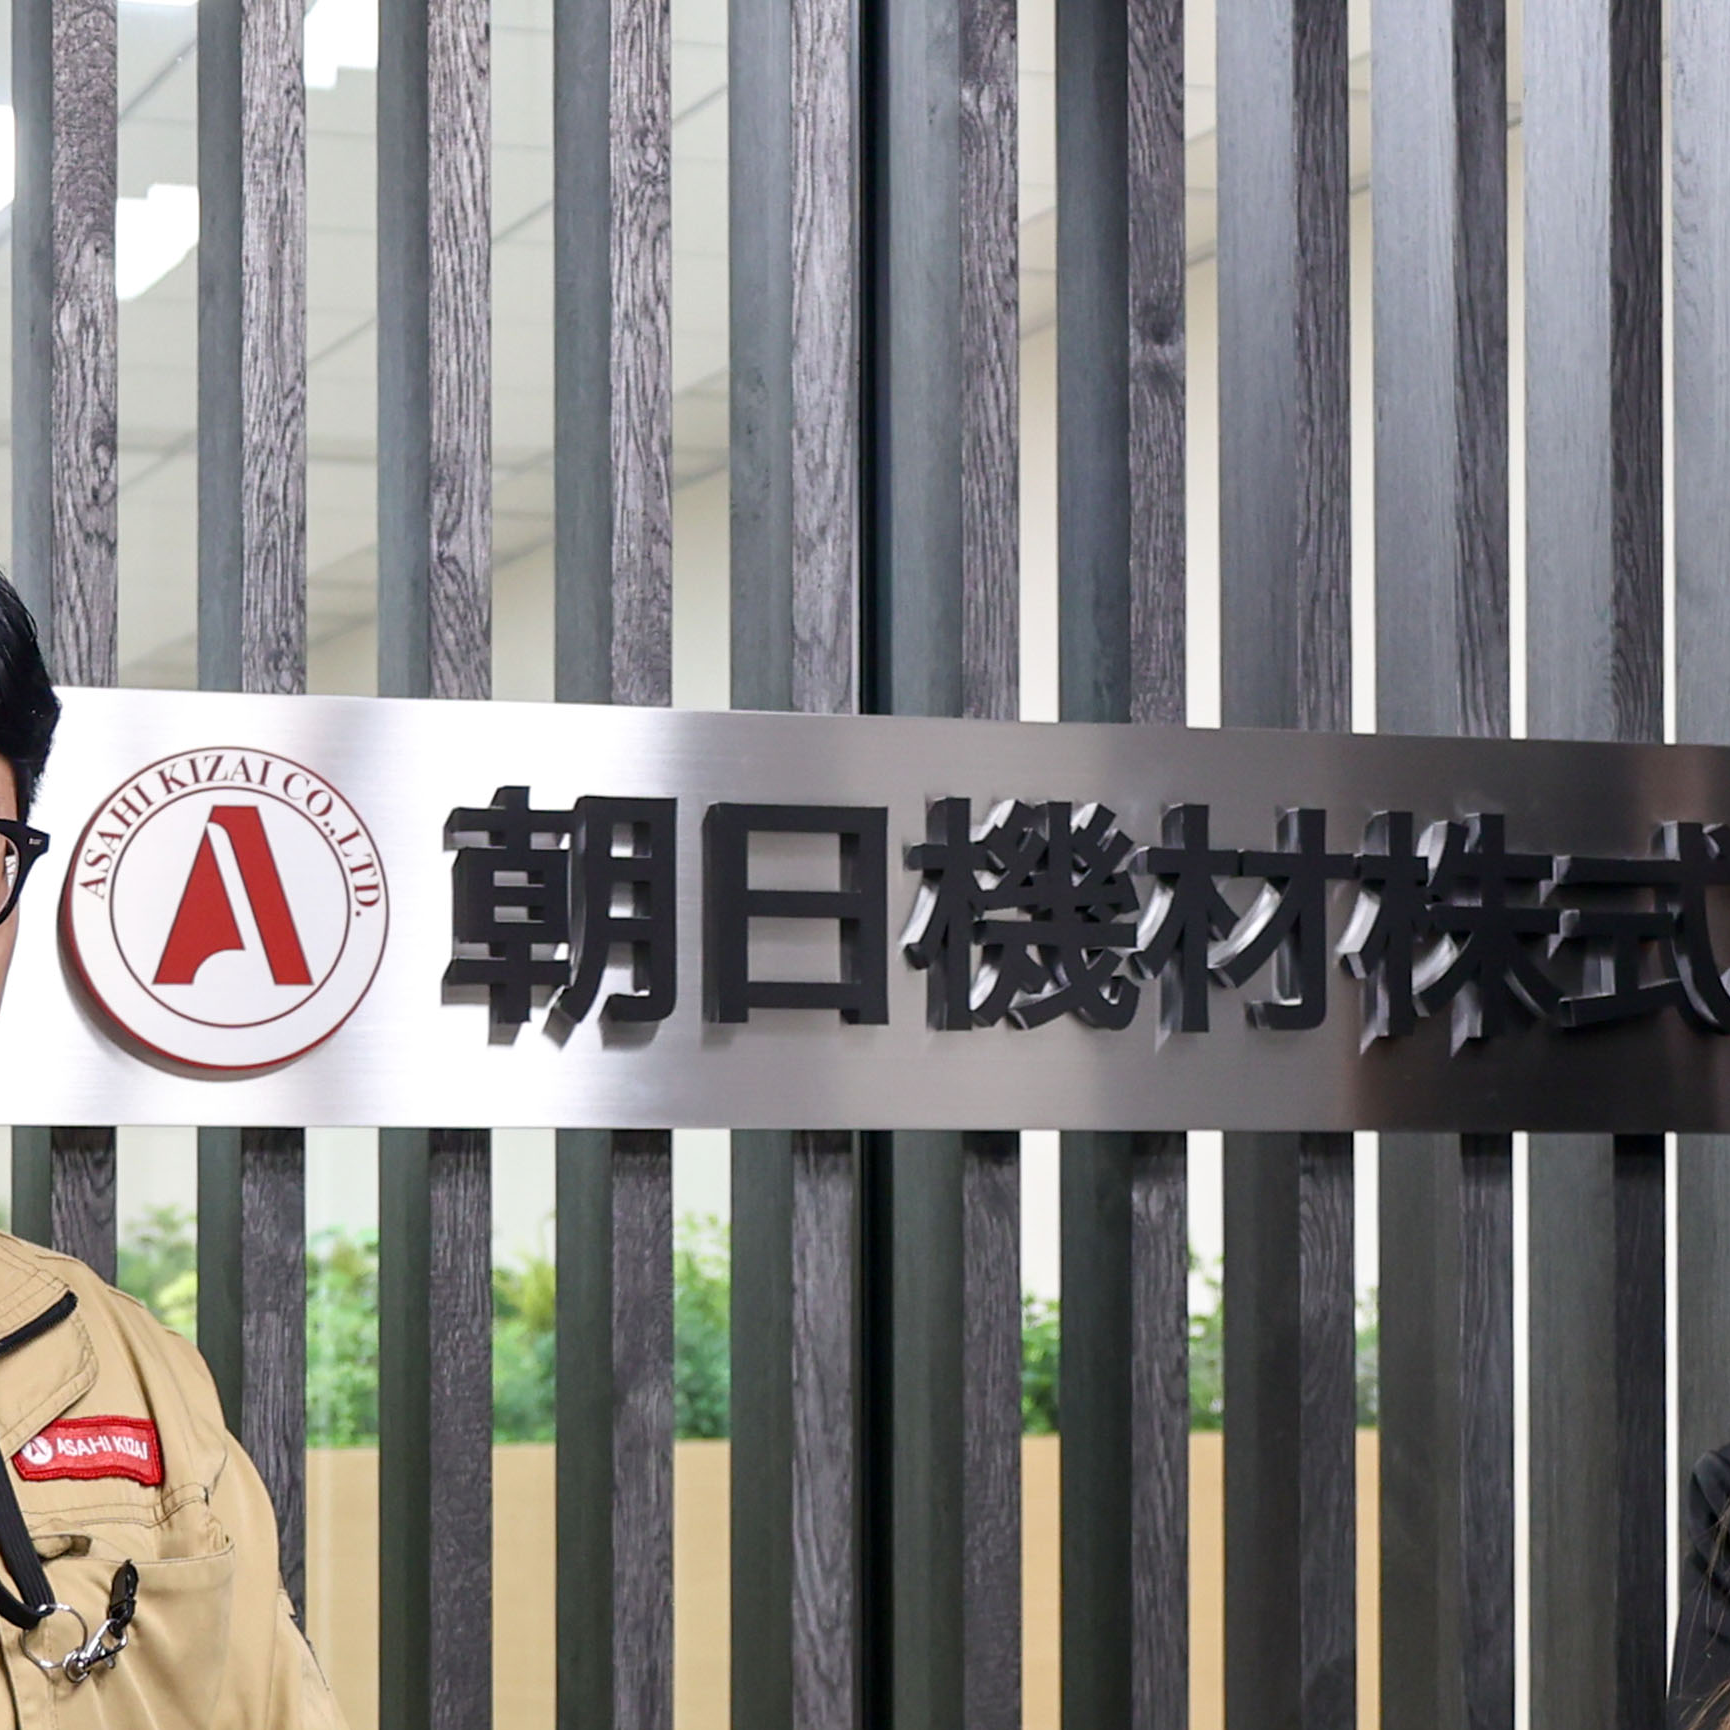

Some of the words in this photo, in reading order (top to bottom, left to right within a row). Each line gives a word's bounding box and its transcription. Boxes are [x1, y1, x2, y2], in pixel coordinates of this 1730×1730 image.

[79, 783, 155, 900] ASAHI
[157, 754, 273, 796] KIZAI
[56, 1435, 112, 1457] ASAHI
[112, 1436, 149, 1460] KIZAI
